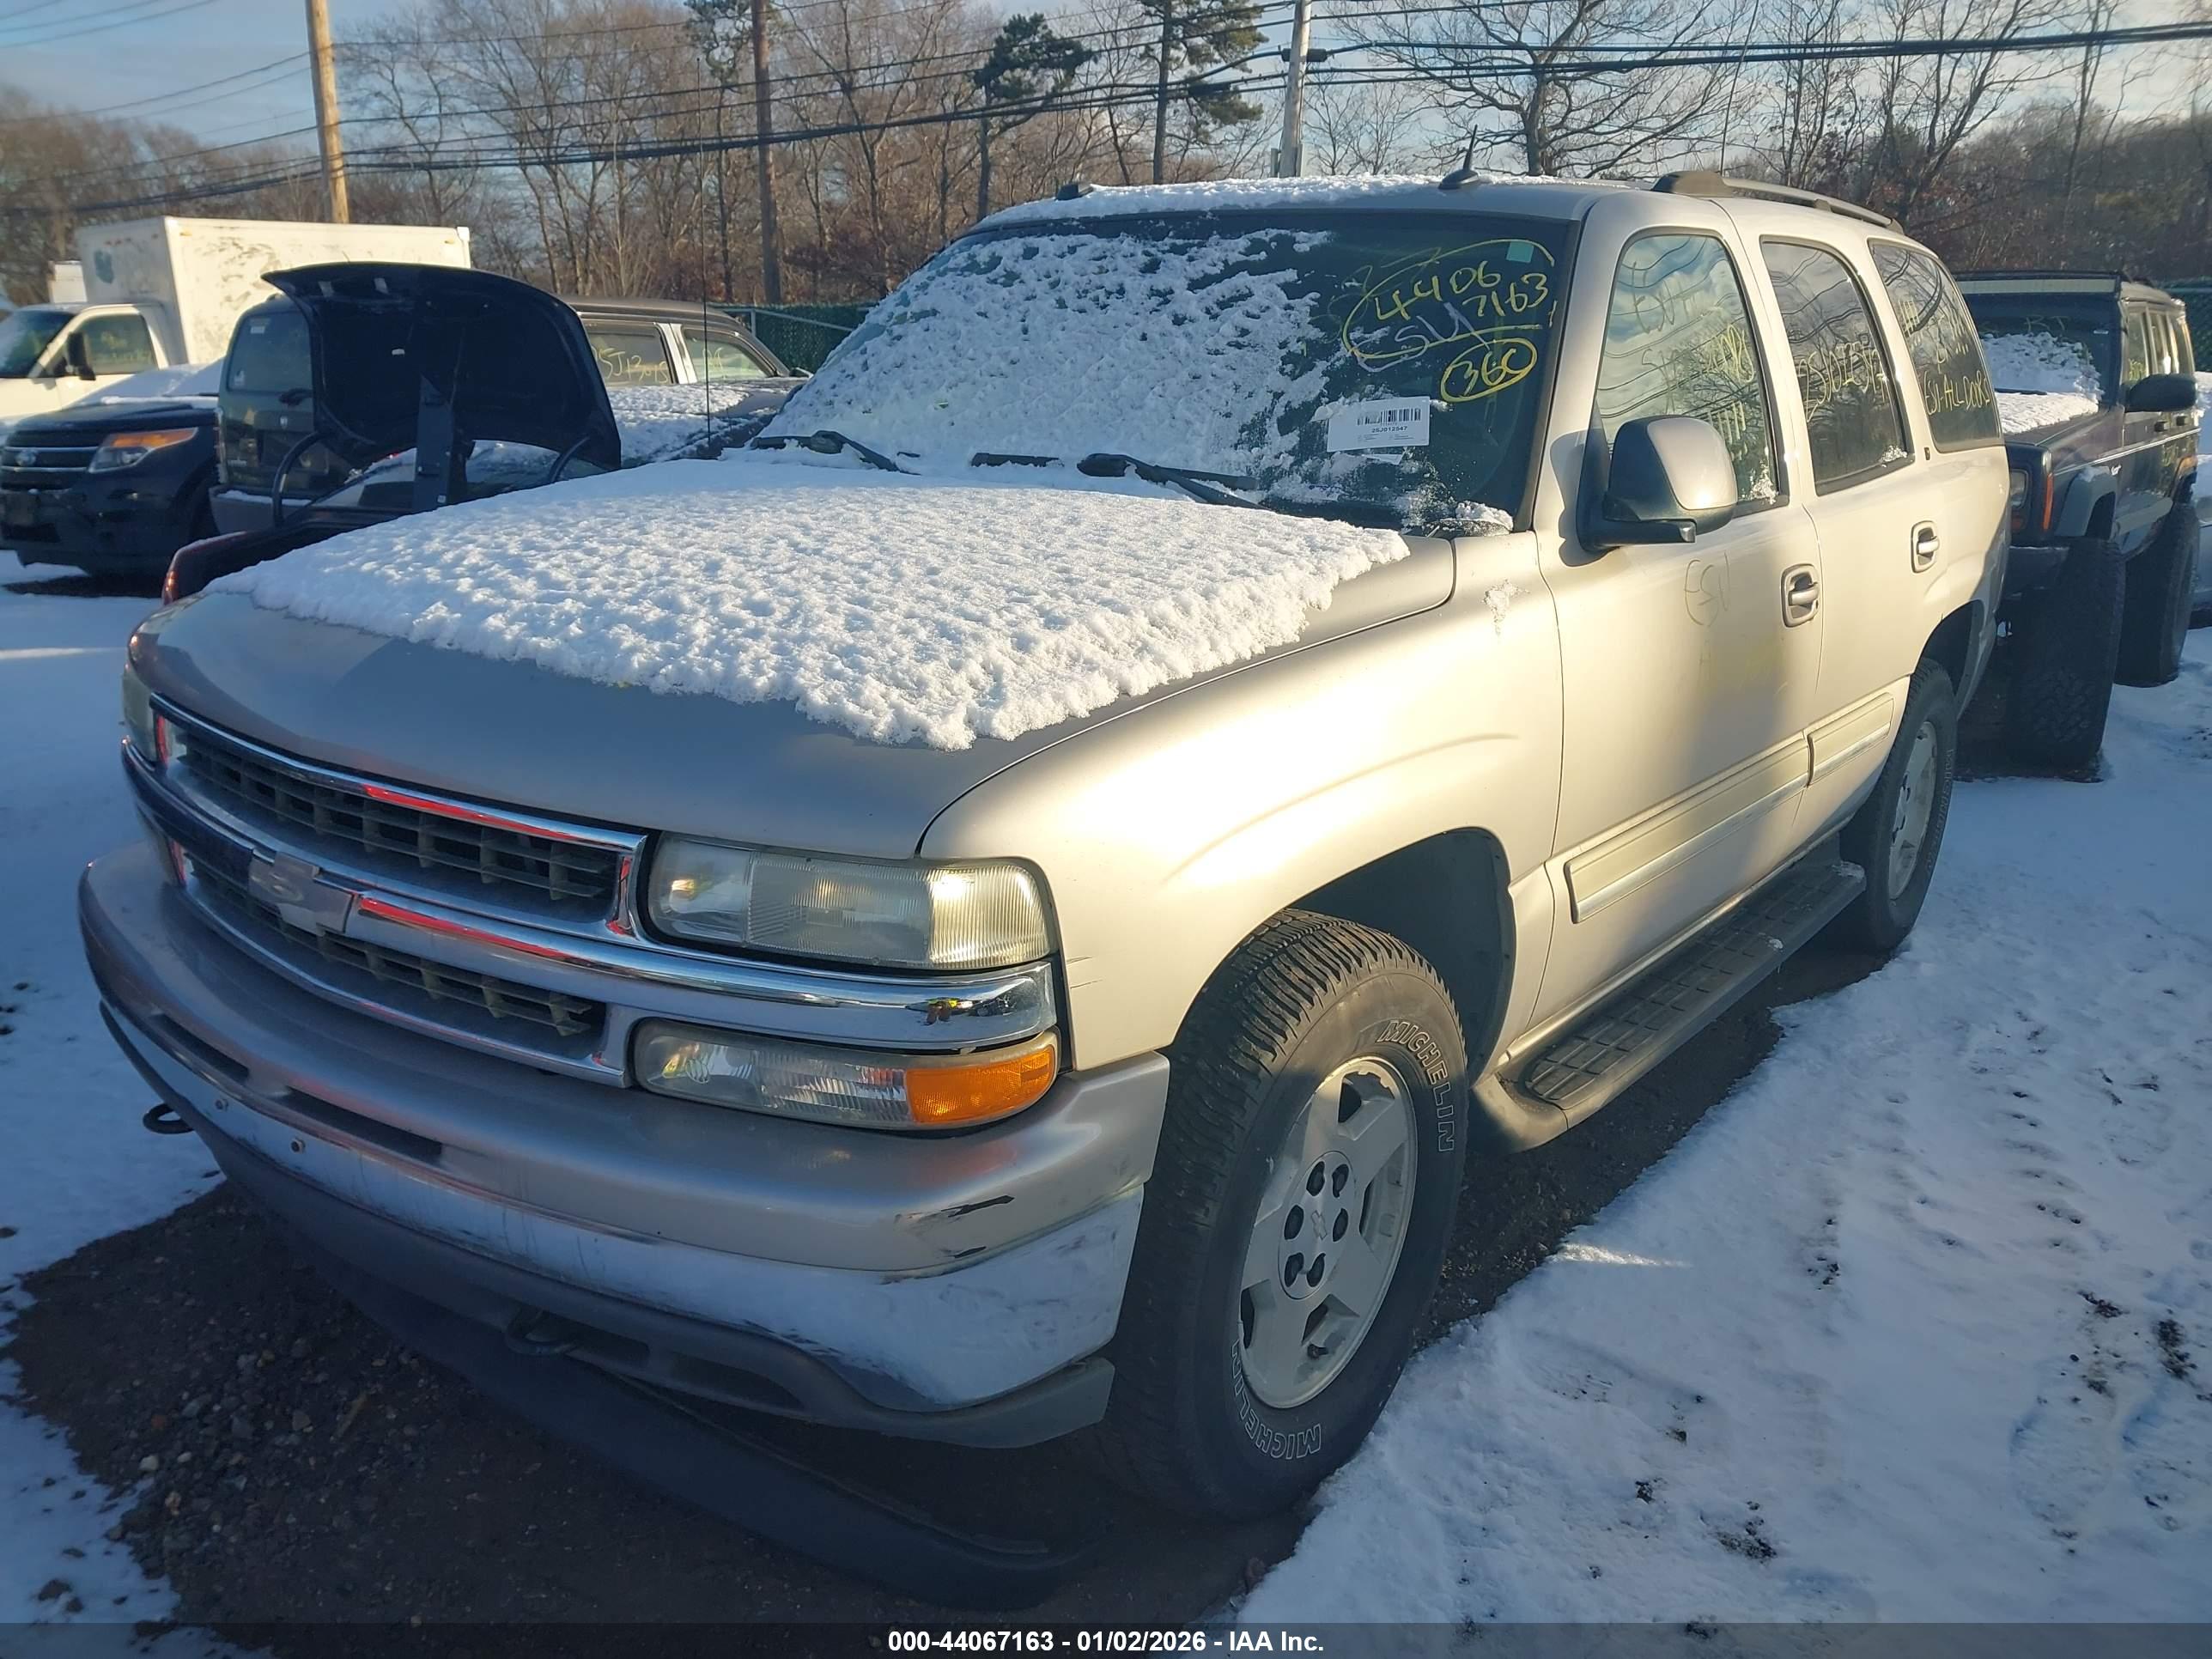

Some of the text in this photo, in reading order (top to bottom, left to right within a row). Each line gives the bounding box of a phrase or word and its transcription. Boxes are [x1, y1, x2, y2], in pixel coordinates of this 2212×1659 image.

[1375, 260, 1501, 321] 4406
[1462, 273, 1548, 318] 7163
[1449, 347, 1534, 398] 360
[1376, 1018, 1455, 1153] MICHELIN
[1231, 1339, 1323, 1461] MICHELIN
